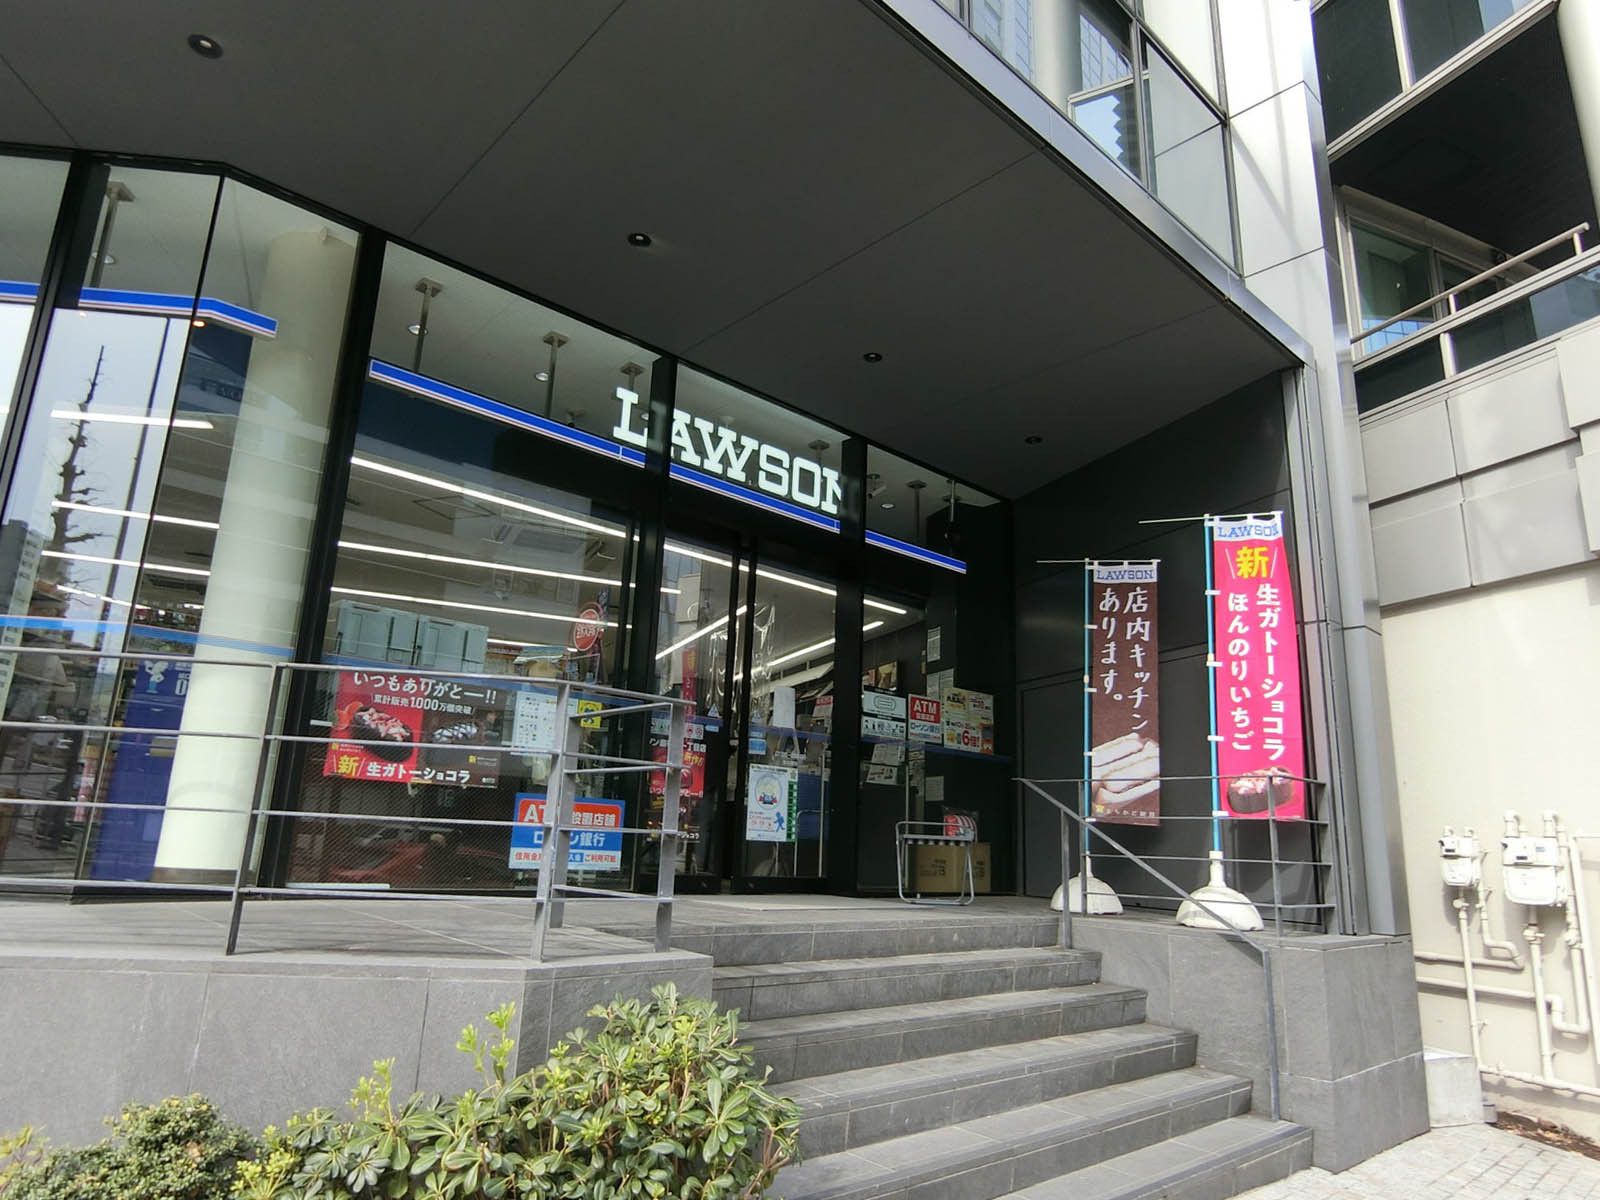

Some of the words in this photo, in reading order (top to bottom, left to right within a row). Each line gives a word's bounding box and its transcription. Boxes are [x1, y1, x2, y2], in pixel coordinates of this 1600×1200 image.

[613, 386, 842, 515] LAWSON
[1096, 569, 1154, 580] LAWSON
[1235, 545, 1270, 579] 新
[1099, 587, 1123, 701] あります。
[1123, 586, 1151, 730] 店内キッチン
[1227, 592, 1255, 751] ほんのりいちご
[1255, 583, 1286, 761] 生ガトーショコラ
[913, 700, 937, 713] ATM
[338, 754, 360, 776] 新
[366, 761, 471, 784] 生ガトーショコラ
[533, 831, 606, 847] ロン銀行
